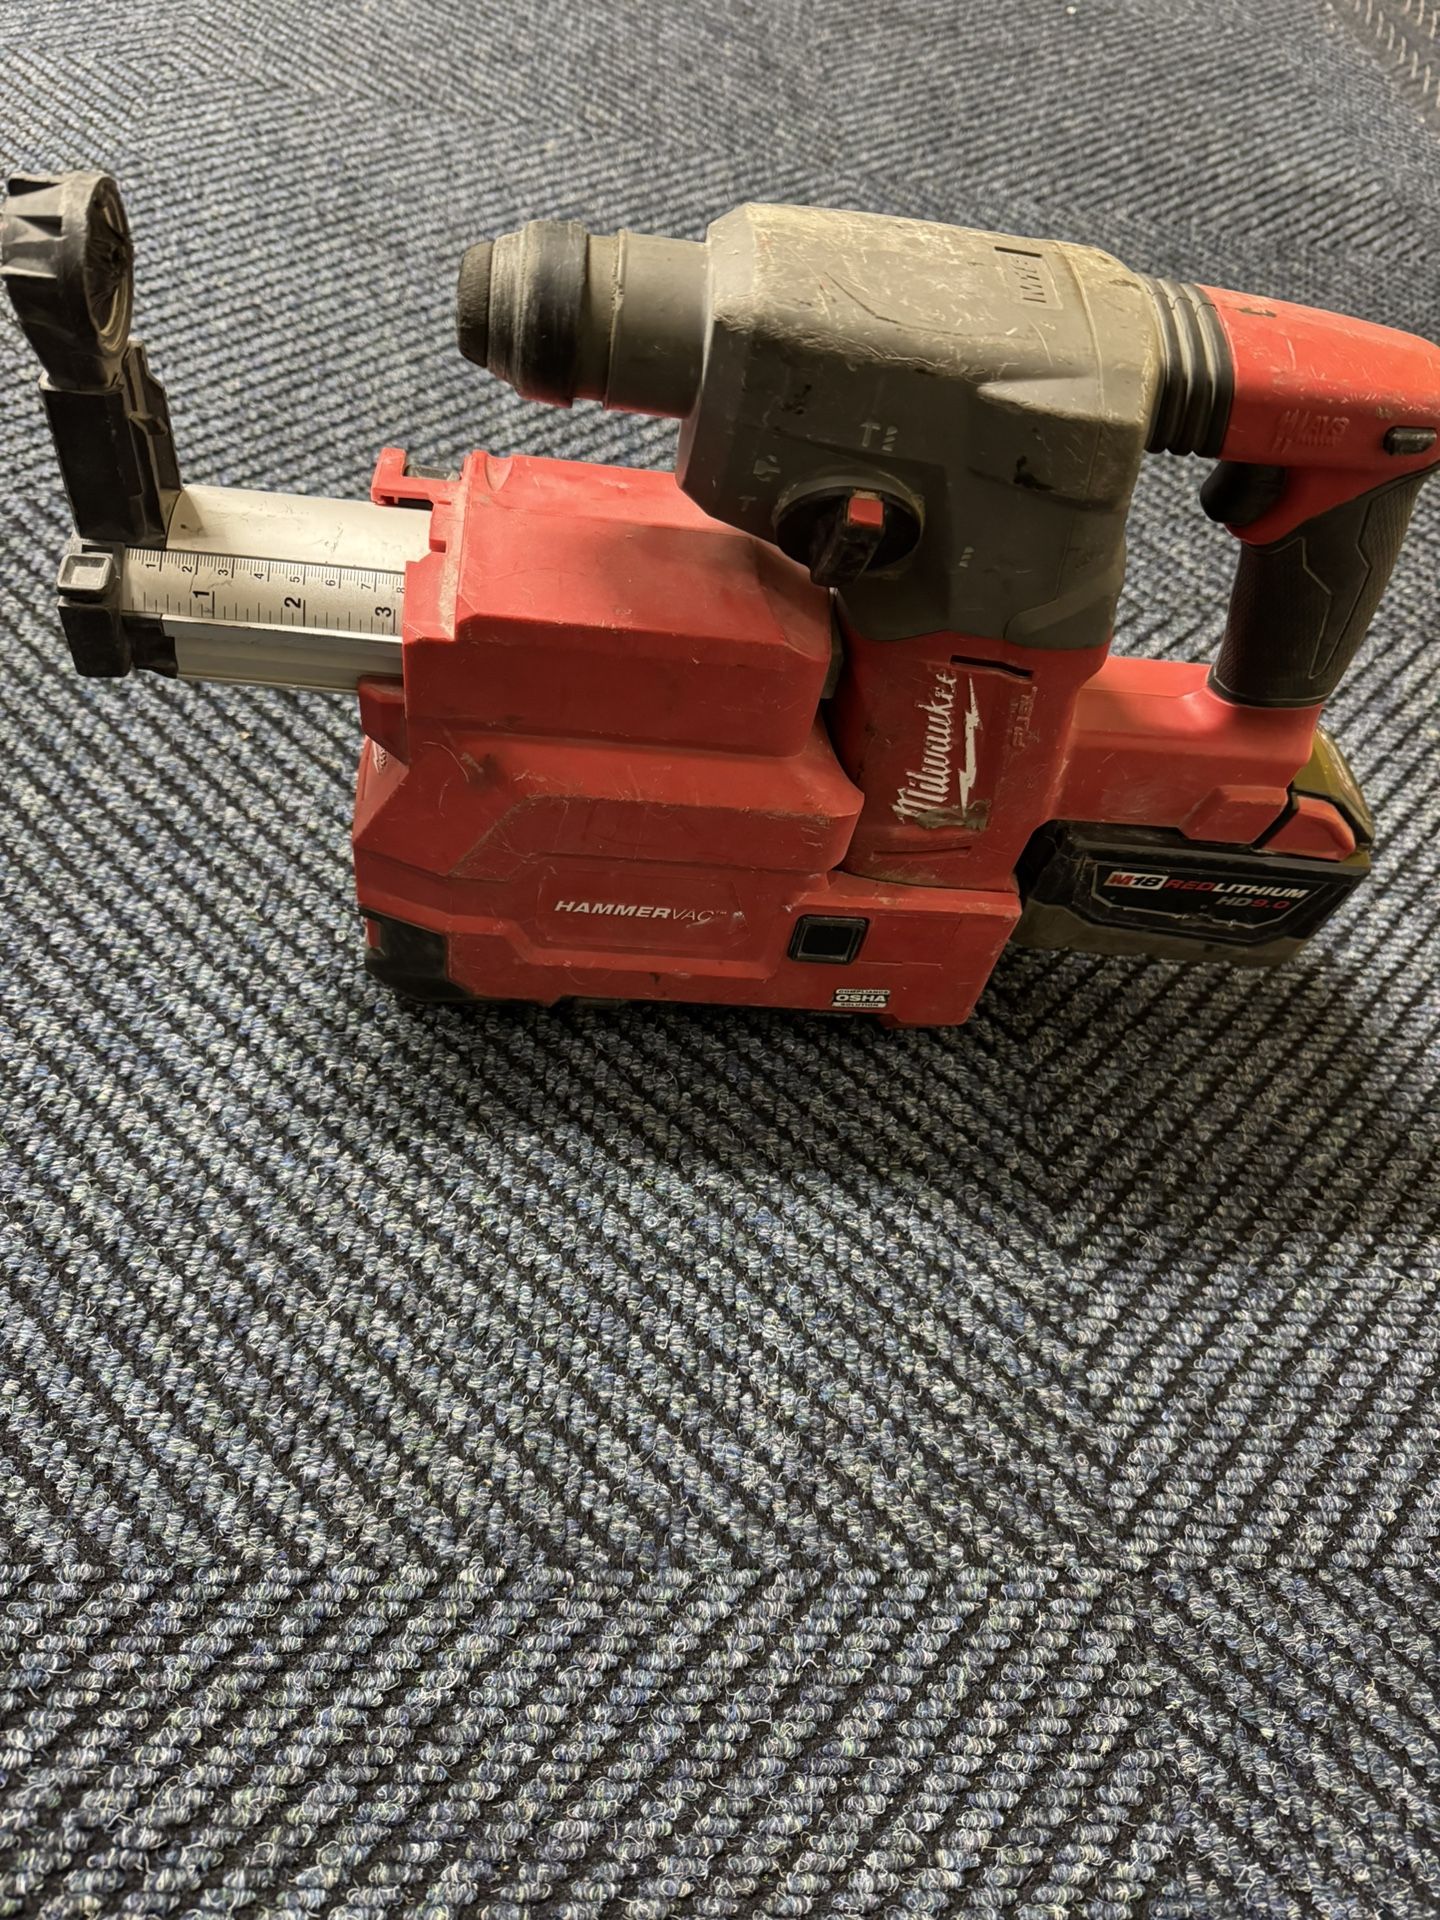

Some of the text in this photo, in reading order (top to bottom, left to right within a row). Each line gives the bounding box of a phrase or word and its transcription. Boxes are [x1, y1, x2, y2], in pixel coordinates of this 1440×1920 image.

[181, 565, 193, 573] 2
[253, 572, 265, 580] 4
[289, 576, 301, 584] 5
[325, 579, 336, 587] 6
[192, 590, 392, 618] 1 2 3
[890, 671, 957, 824] Milwaukee
[1107, 873, 1162, 888] M18
[835, 994, 886, 1002] OSHA
